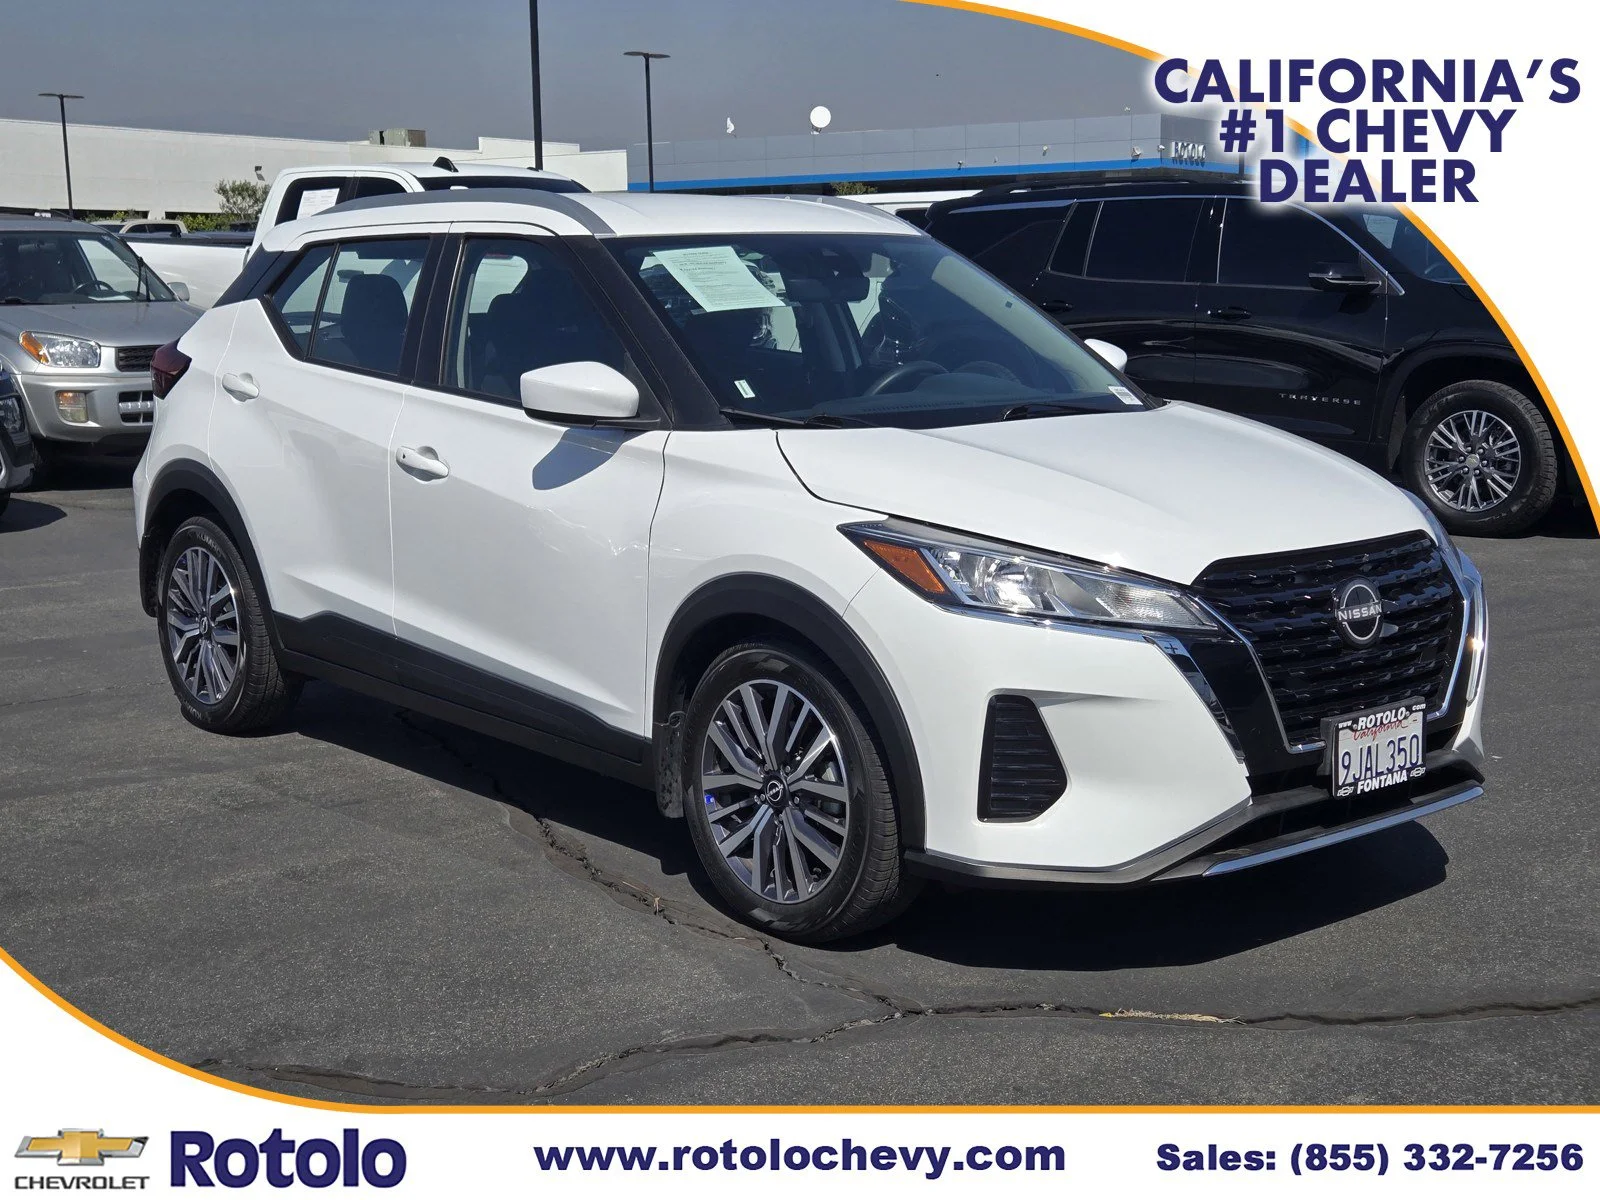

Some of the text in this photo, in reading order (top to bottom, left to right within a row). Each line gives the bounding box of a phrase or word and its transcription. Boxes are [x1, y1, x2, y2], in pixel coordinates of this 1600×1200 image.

[1279, 392, 1361, 406] TRAVERSE
[1337, 603, 1383, 621] NISSAN
[1340, 733, 1420, 787] 9JAL350
[1356, 769, 1409, 795] FONTANA
